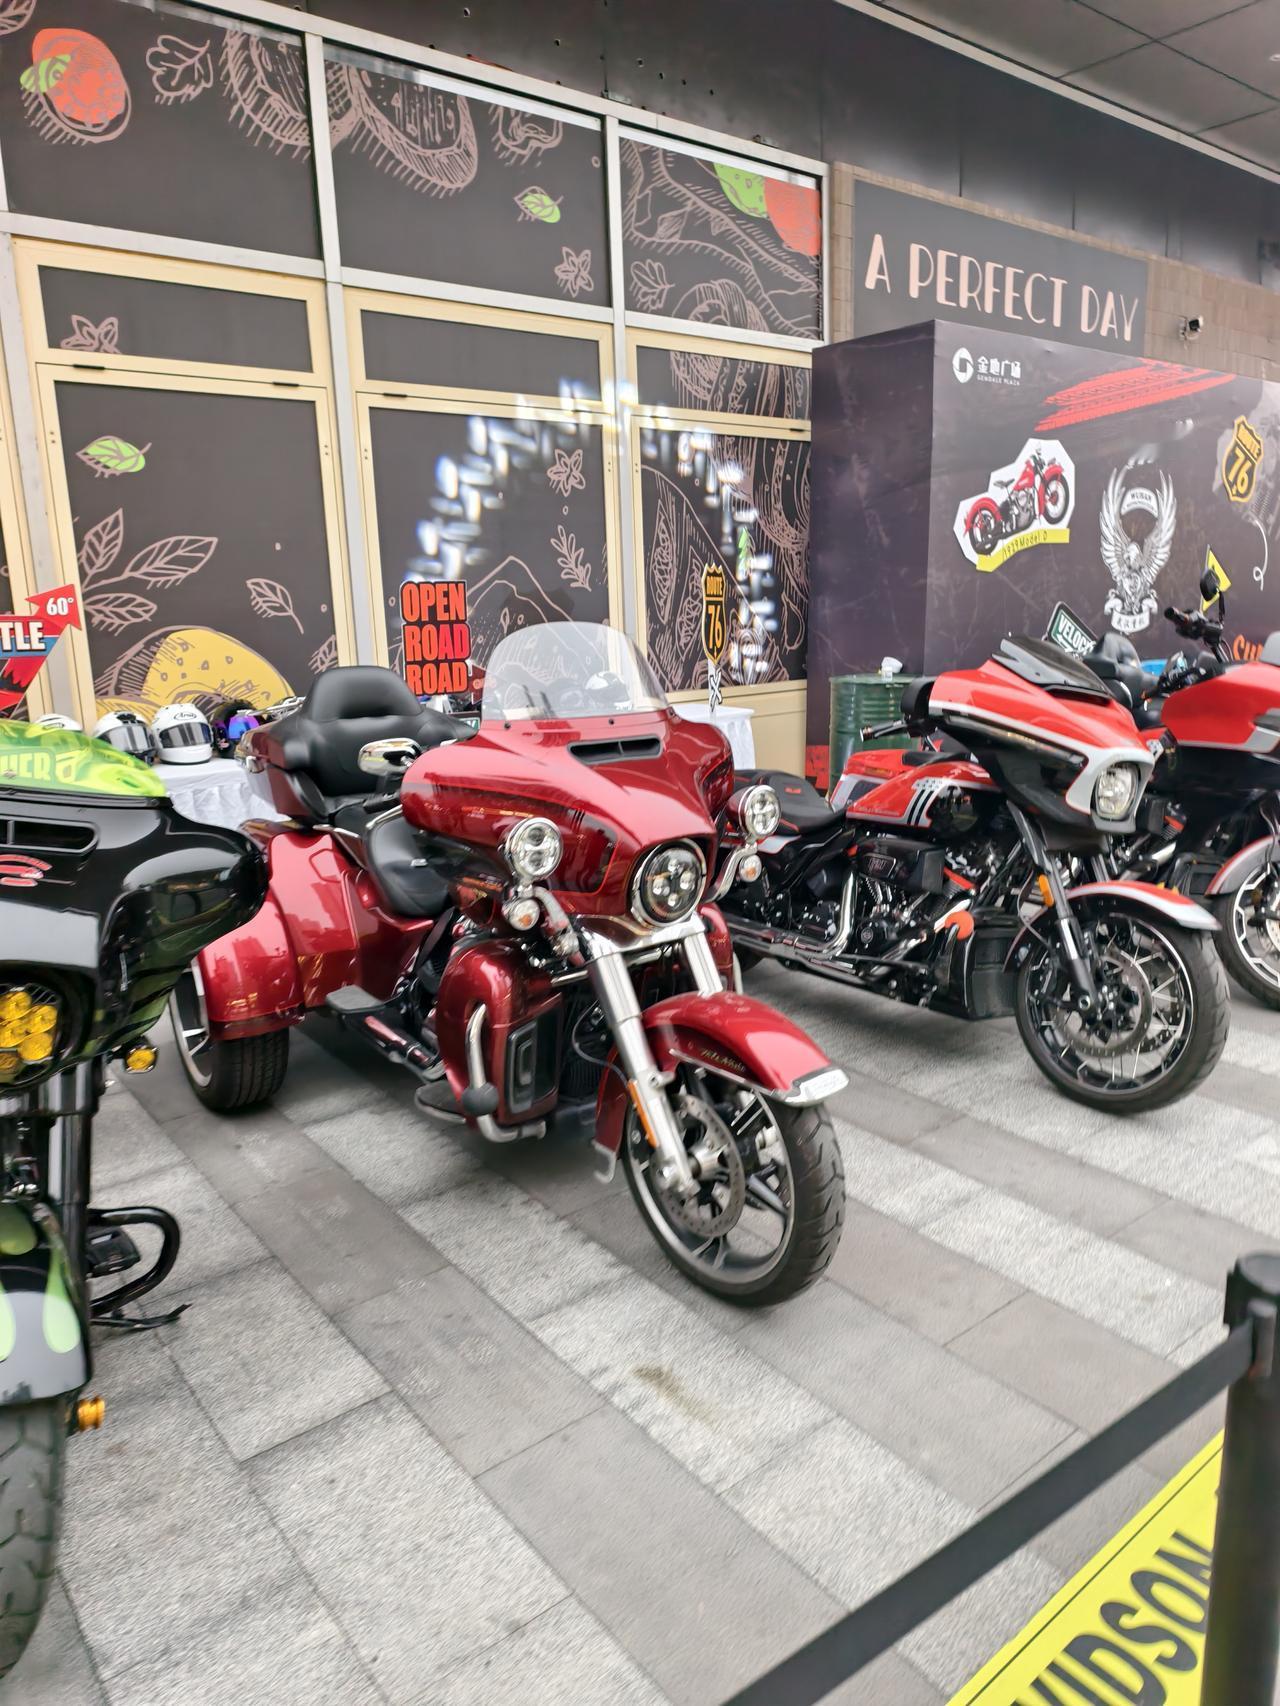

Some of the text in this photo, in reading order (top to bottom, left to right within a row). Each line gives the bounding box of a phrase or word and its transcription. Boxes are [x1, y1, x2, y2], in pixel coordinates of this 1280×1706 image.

[865, 233, 1139, 342] A PERFECT DAY
[1228, 446, 1253, 495] 76
[402, 583, 466, 622] OPEN
[706, 575, 723, 596] ROUTE
[404, 623, 470, 662] ROAD
[707, 604, 723, 650] 76
[406, 661, 468, 695] ROAD
